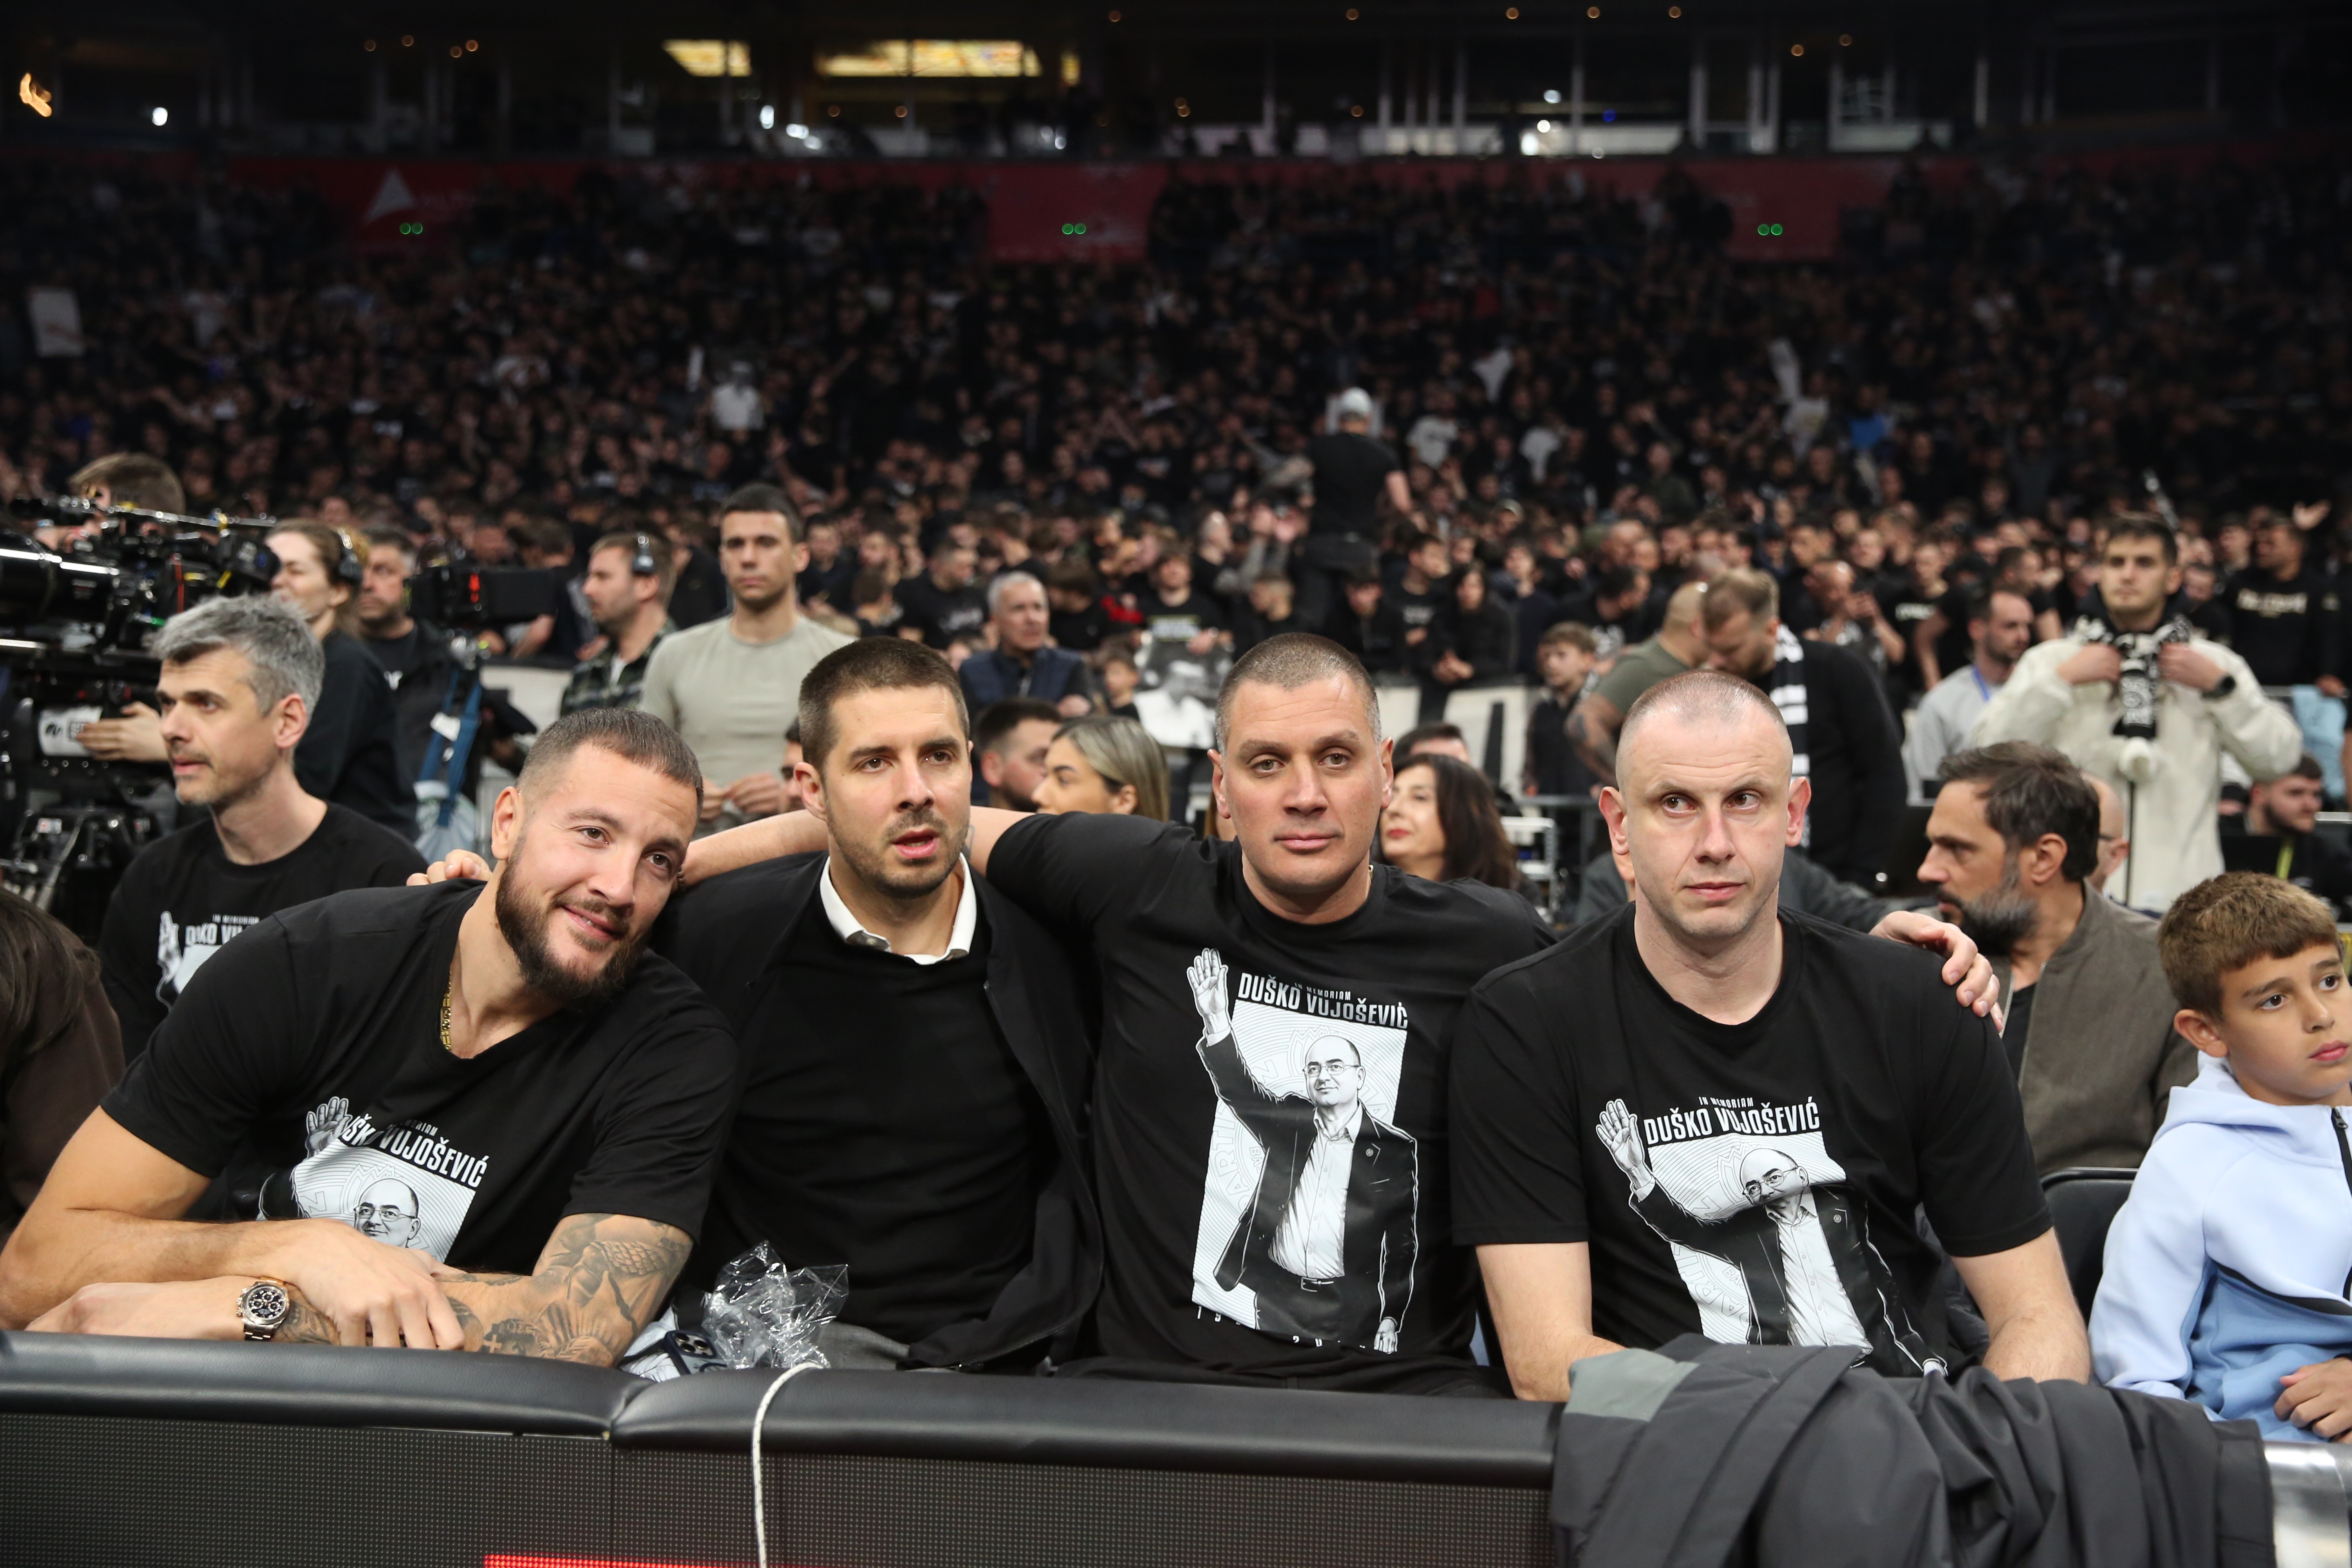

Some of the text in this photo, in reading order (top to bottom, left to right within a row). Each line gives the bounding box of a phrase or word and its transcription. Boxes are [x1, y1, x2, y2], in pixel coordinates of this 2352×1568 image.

[1238, 972, 1408, 1029] DUŠKO VUJOŠEVIĆ
[1306, 986, 1351, 1001] MEMORIAM
[1643, 1096, 1820, 1145] DUŠKO VUJOŠEVIĆ
[1698, 1096, 1754, 1109] IN MEMORIAM
[379, 1124, 490, 1188] VUJOŠEVIĆ
